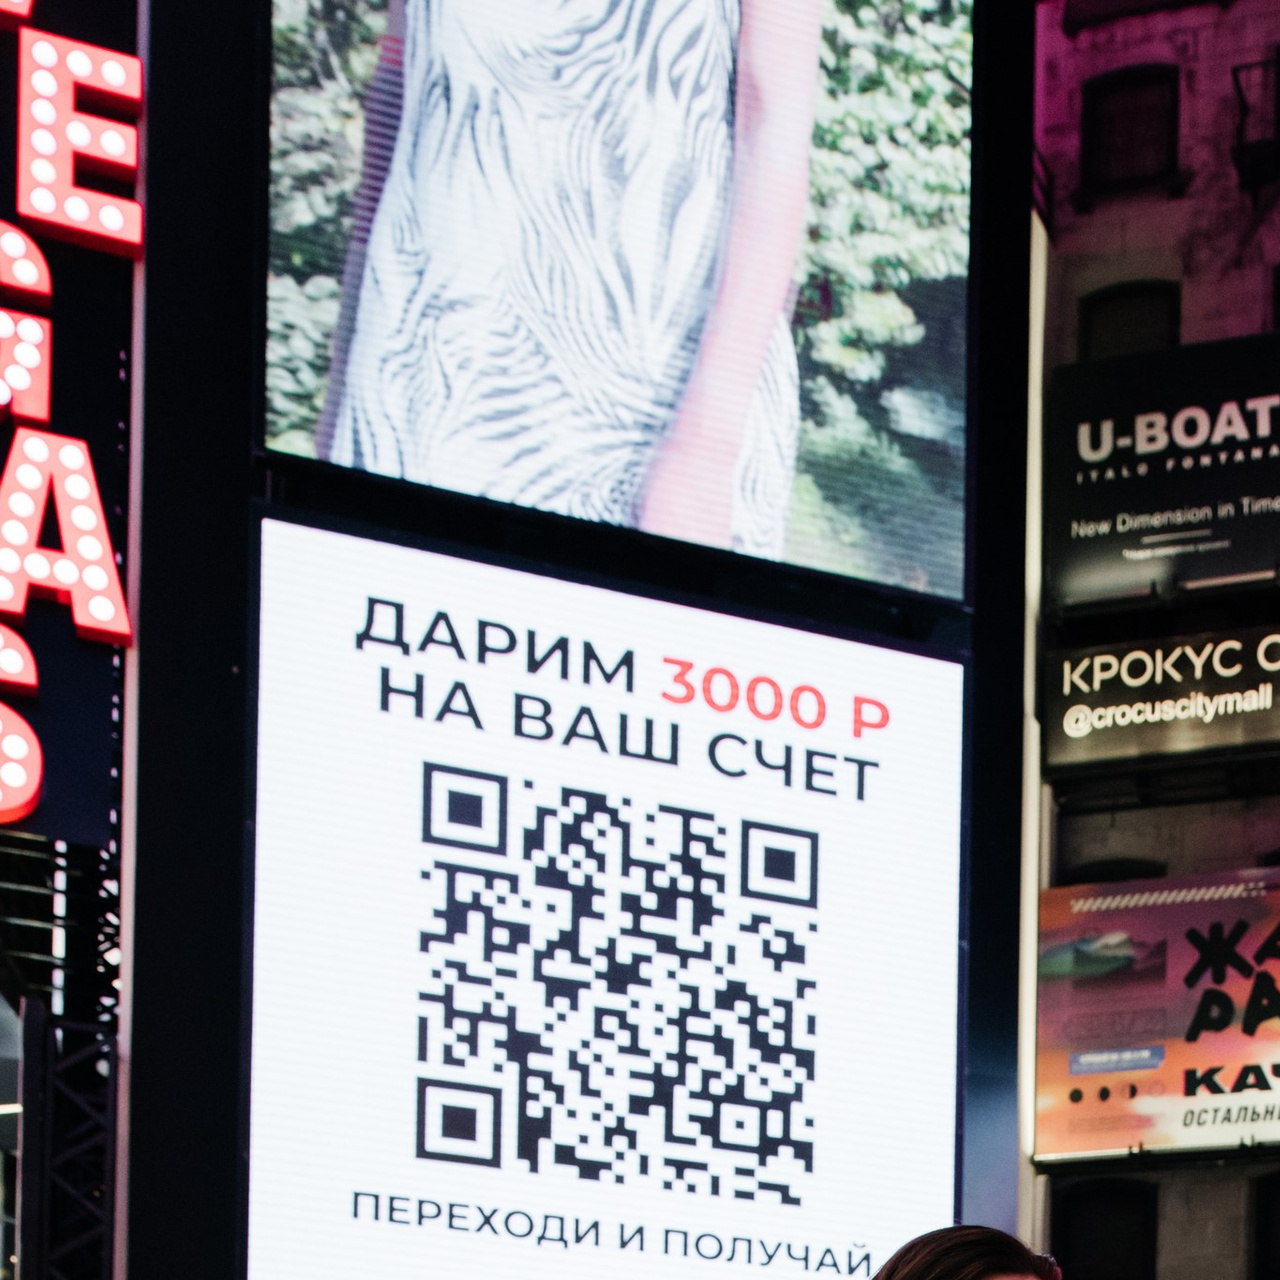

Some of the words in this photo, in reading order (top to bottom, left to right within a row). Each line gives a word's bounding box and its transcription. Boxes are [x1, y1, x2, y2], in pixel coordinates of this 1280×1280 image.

[1076, 462, 1149, 485] ITALO
[1166, 443, 1280, 472] FONTANA
[1116, 505, 1213, 533] Dimension
[1217, 501, 1235, 518] in
[356, 596, 635, 693] ДАРИМ
[662, 656, 826, 730] 3000
[1063, 639, 1243, 696] КРОКУС
[379, 665, 484, 731] НА
[514, 694, 680, 766] ВАШ
[708, 733, 879, 802] СЧЕТ
[1063, 682, 1273, 738] @crocuscitymall
[351, 1190, 600, 1249] ПЕРЕХОДИ
[619, 1219, 644, 1253] И
[663, 1228, 872, 1278] ПОЛУЧАЙ
